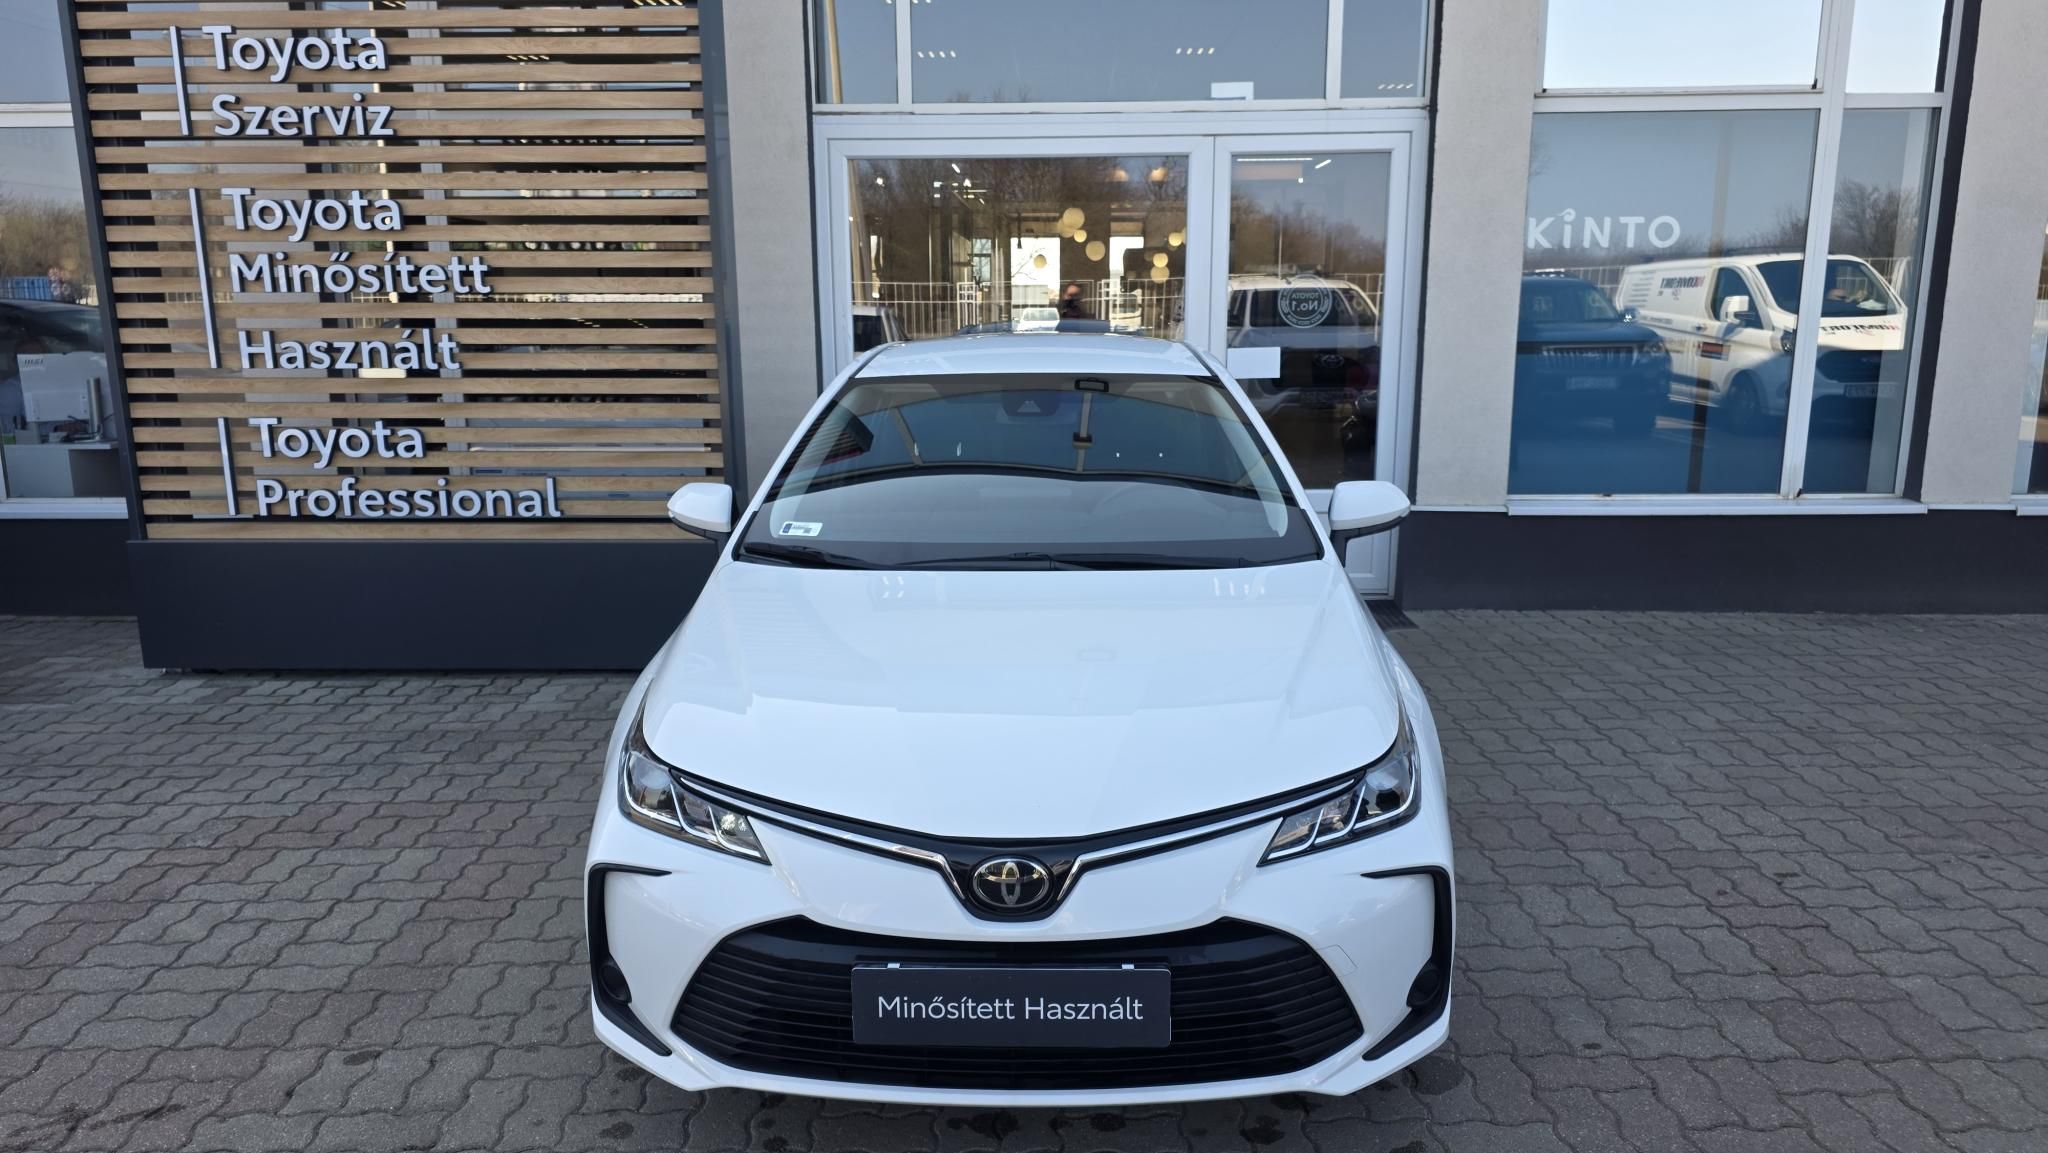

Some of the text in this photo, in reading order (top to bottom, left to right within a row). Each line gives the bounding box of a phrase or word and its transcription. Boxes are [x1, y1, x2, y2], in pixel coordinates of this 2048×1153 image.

[202, 25, 388, 82] Toyota
[211, 92, 395, 136] Szerviz
[221, 187, 403, 242] Toyota
[229, 251, 492, 294] Minősített
[238, 328, 461, 370] Használt
[248, 417, 425, 469] Toyota
[256, 477, 562, 518] Professional
[877, 995, 1144, 1021] Minősített Használt
